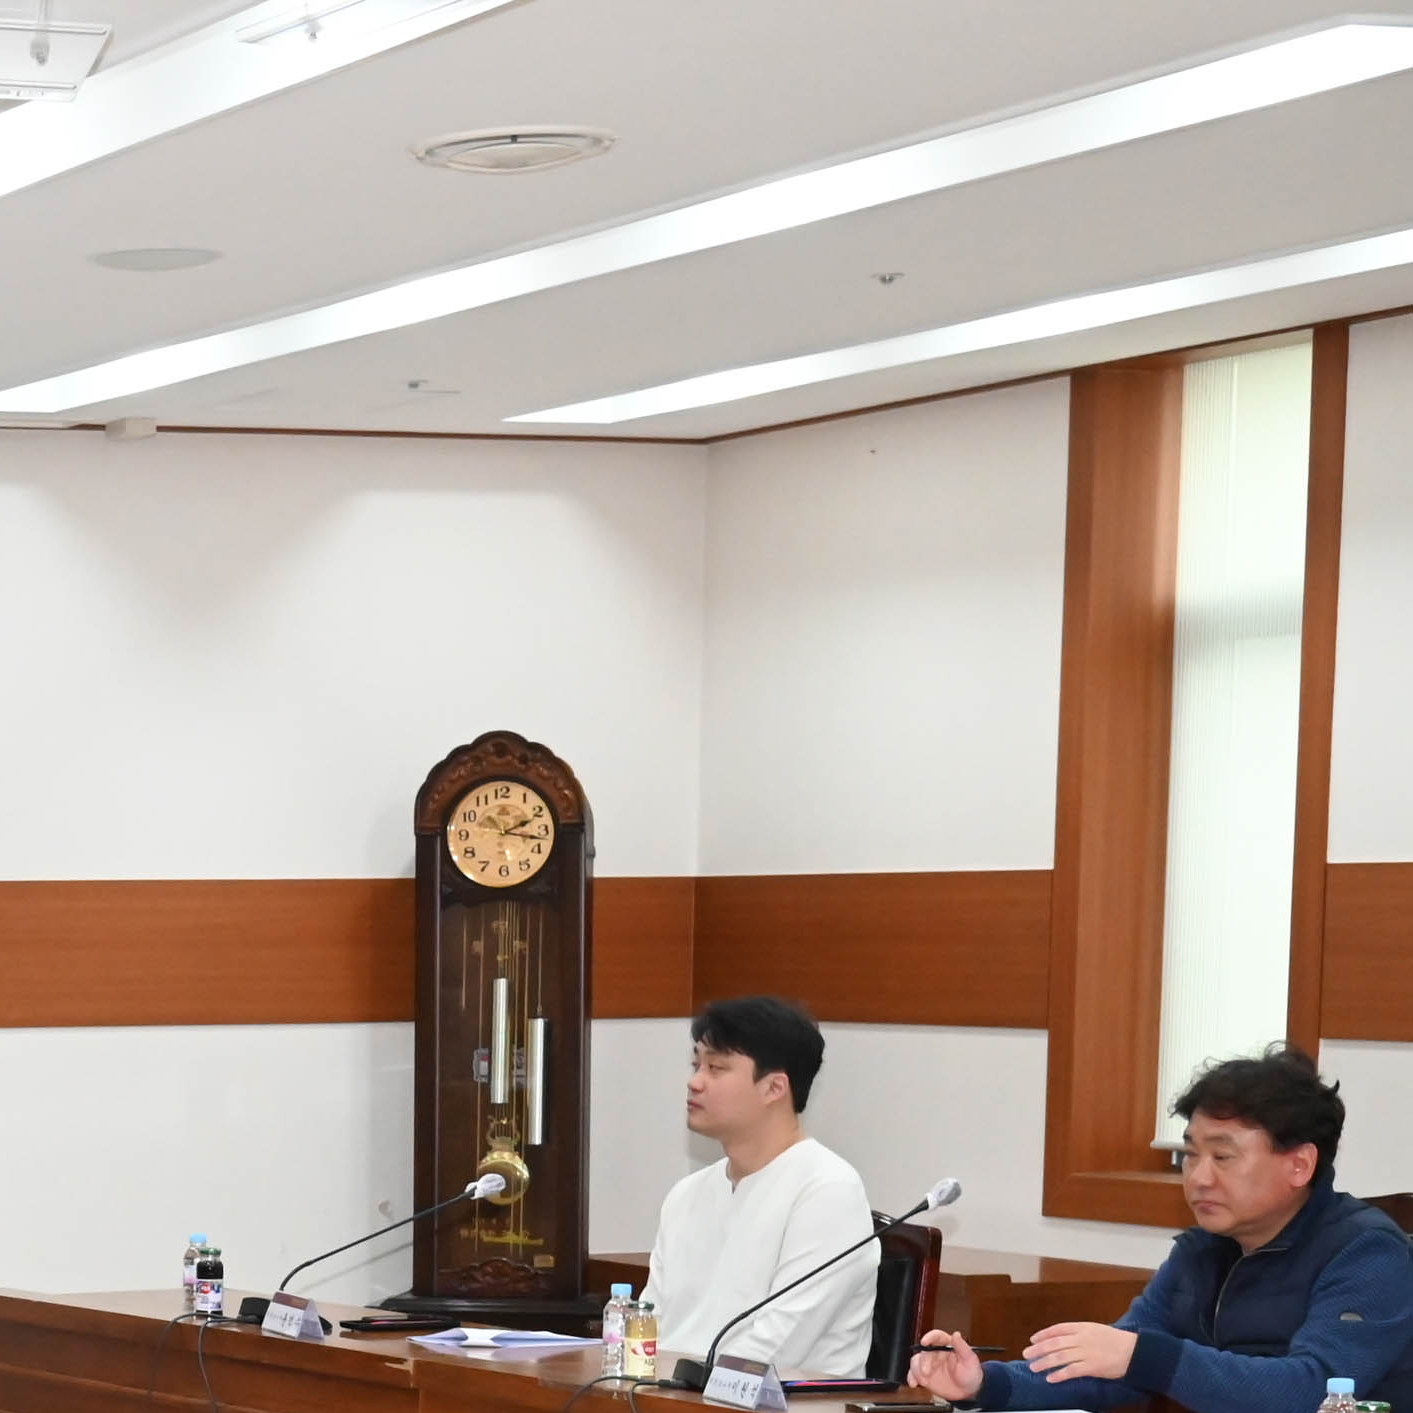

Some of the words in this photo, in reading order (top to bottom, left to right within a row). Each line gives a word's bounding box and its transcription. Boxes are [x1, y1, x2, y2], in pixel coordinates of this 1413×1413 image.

[494, 786, 511, 800] 12
[476, 794, 489, 807] 11
[463, 810, 477, 823] 10
[533, 805, 544, 818] 2
[458, 829, 470, 841] 9
[537, 824, 549, 837] 3
[463, 847, 476, 859] 8
[530, 843, 542, 855] 4
[478, 861, 490, 872] 7
[498, 864, 510, 878] 6
[518, 859, 531, 872] 5
